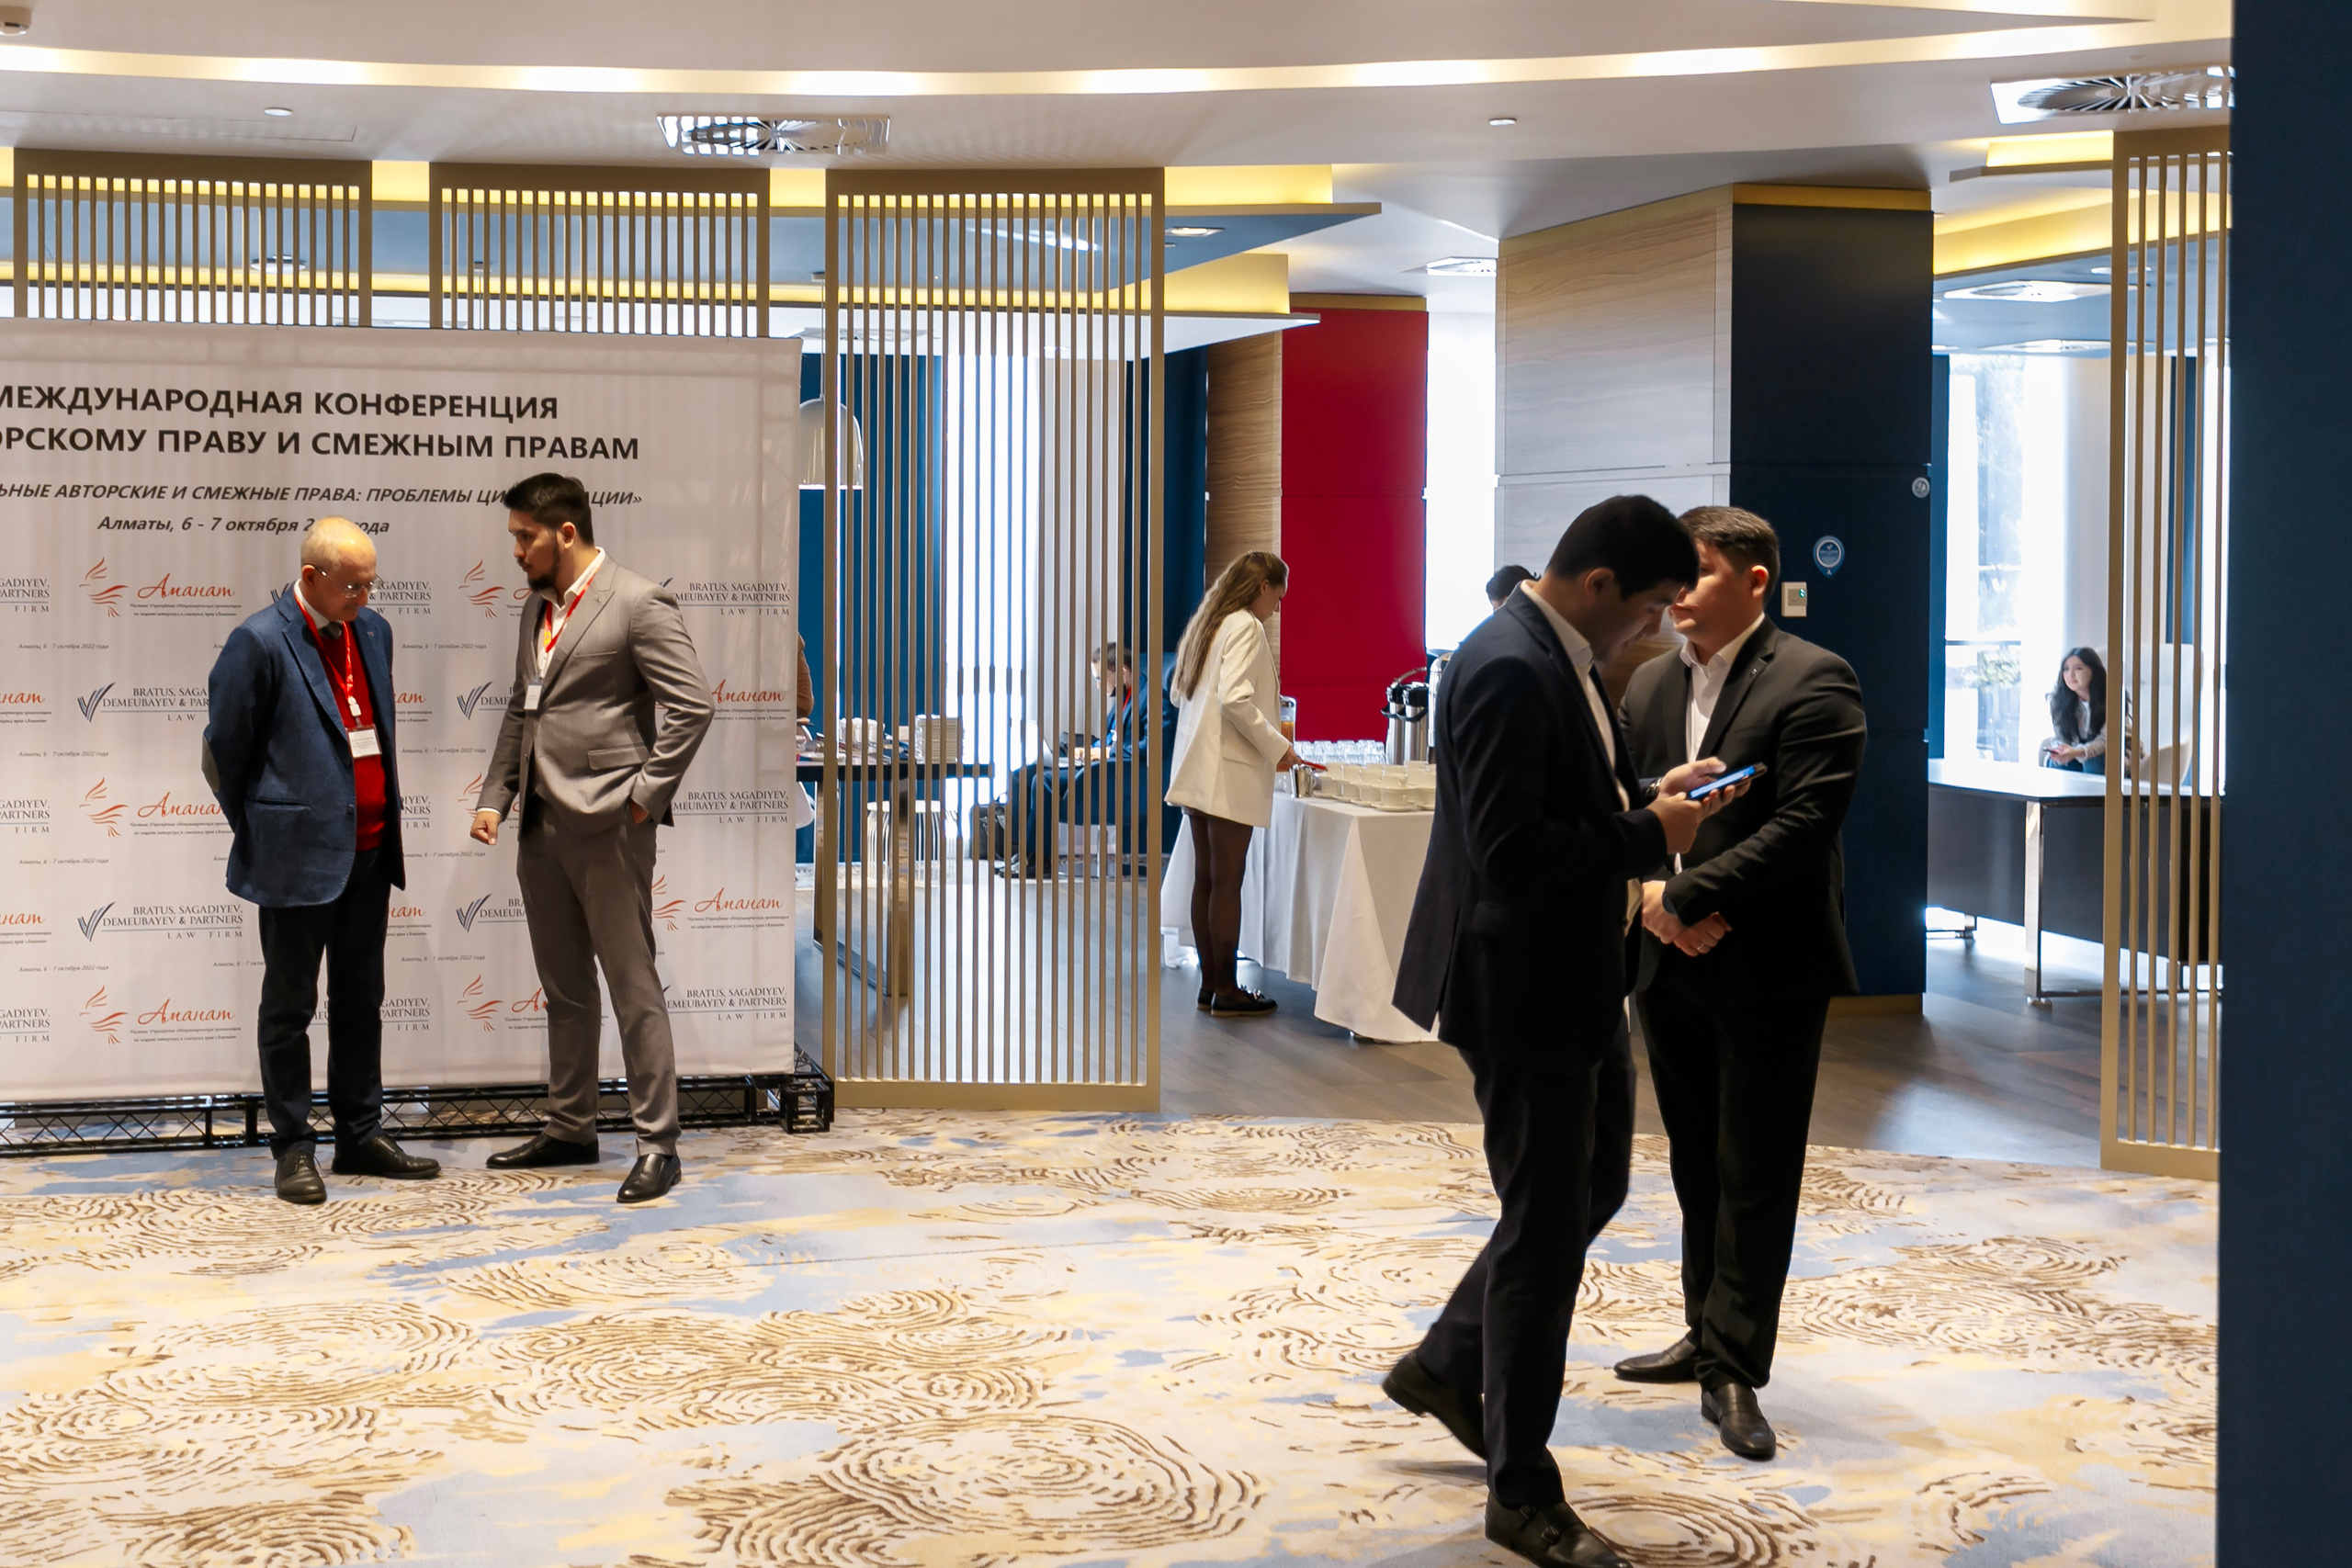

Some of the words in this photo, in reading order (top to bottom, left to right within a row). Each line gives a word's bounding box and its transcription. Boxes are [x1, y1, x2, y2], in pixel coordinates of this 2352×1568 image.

[314, 391, 558, 424] КОНФЕРЕНЦИЯ
[0, 426, 147, 452] РСКОМУ
[158, 429, 266, 455] ПРАВУ
[277, 431, 300, 455] И
[311, 432, 493, 457] СМЕЖНЫМ
[505, 435, 639, 460] ПРАВАМ
[54, 484, 167, 500] АВТОРСКИЕ
[172, 486, 187, 500] И
[192, 486, 291, 502] СМЕЖНЫЕ
[294, 487, 362, 502] ПРАВА:
[367, 488, 473, 503] ПРОБЛЕМЫ
[96, 515, 174, 533] Алматы,
[181, 516, 193, 531] 6
[210, 516, 222, 531] 7
[225, 516, 300, 536] октября
[355, 522, 390, 536] ода
[0, 589, 50, 598] ARTNERS
[379, 592, 432, 601] PARTNERS
[674, 592, 729, 602] MEUBAYEV
[741, 592, 790, 602] PARTNERS
[0, 692, 46, 704] нат
[103, 698, 176, 707] DEMEUBAYEV
[137, 791, 222, 818] Амана
[672, 801, 727, 810] MEUBAYEV
[740, 800, 788, 809] PARTNERS
[0, 810, 51, 818] ARTNERS
[0, 913, 46, 925] нат
[103, 916, 176, 927] DEMEUBAYEV
[190, 915, 243, 924] PARTNERS
[667, 998, 726, 1009] EMEUBAYEV
[739, 997, 787, 1007] PARTNERS
